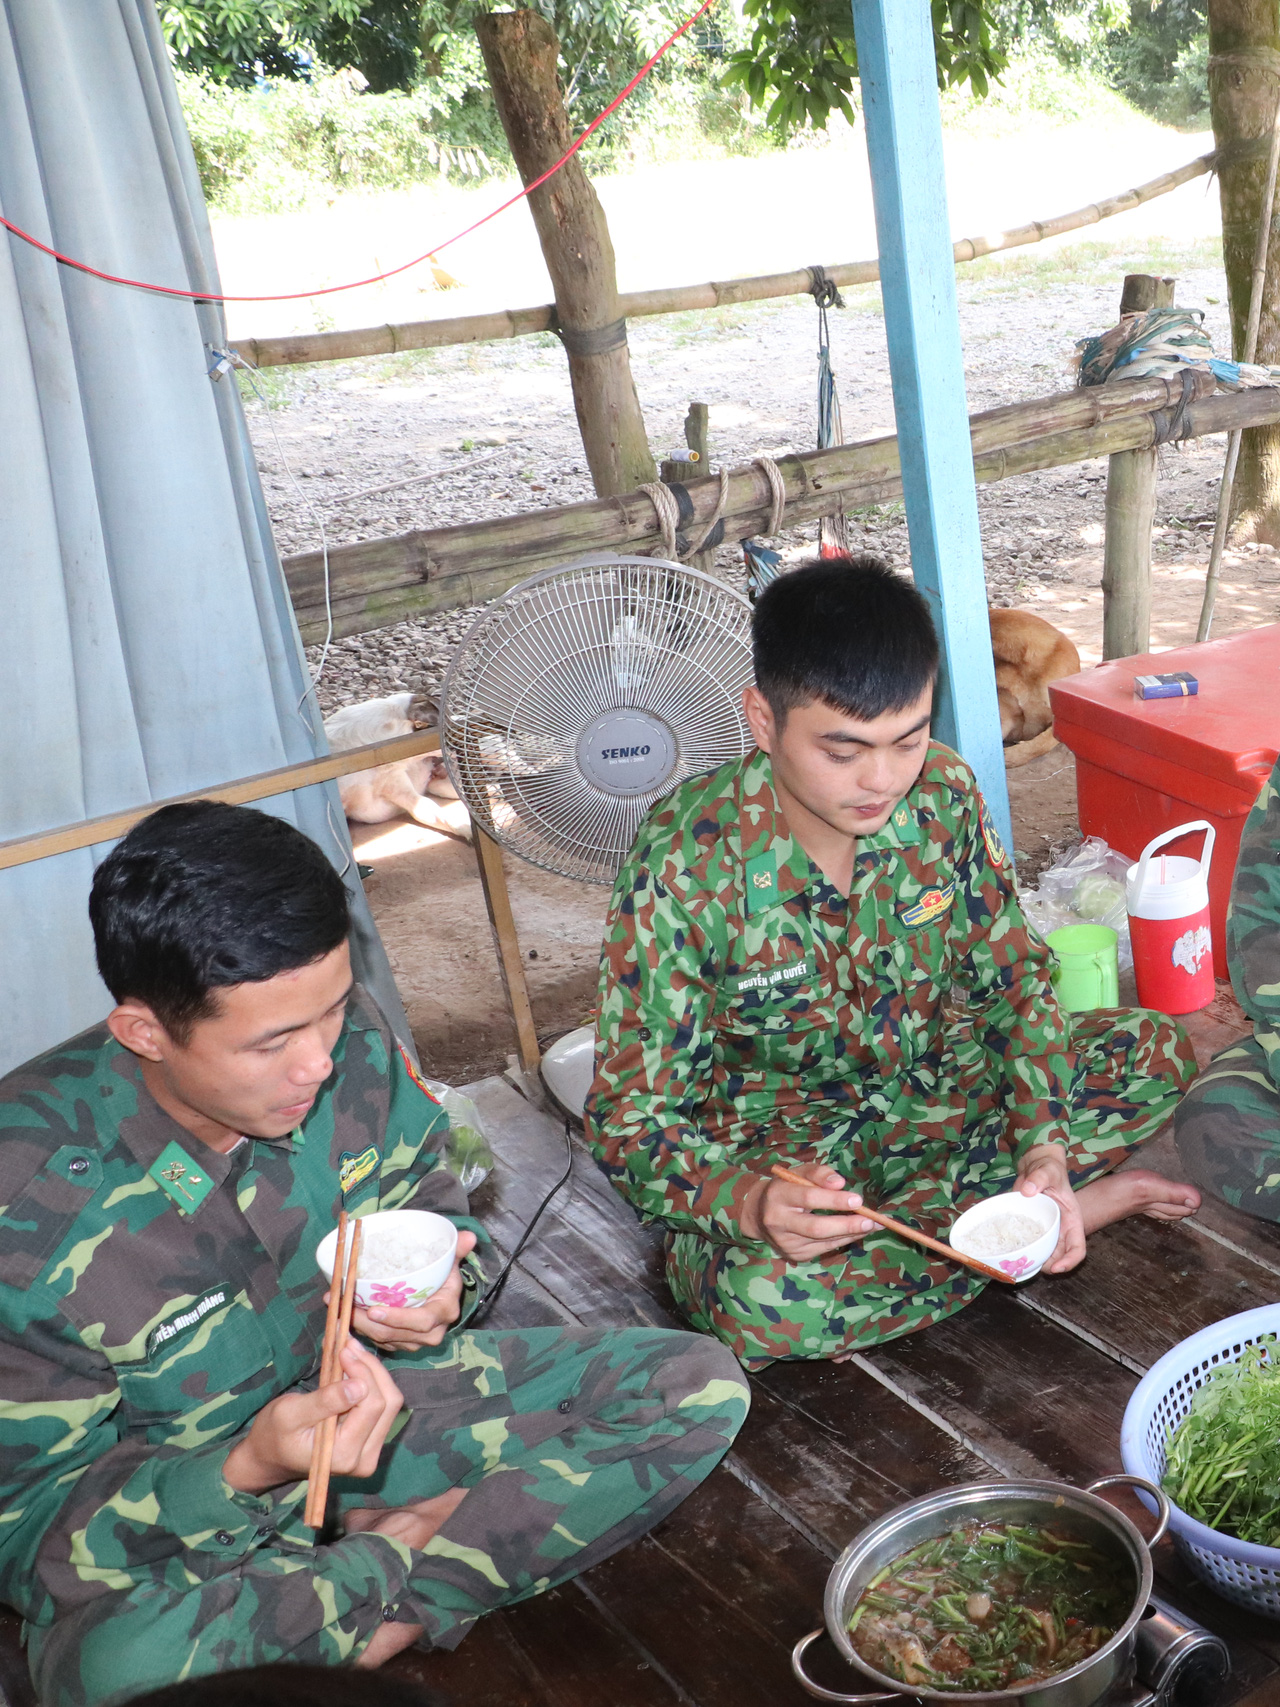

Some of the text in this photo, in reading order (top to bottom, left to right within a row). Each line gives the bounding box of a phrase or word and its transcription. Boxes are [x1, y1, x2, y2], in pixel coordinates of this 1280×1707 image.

[601, 744, 651, 760] SENKO
[173, 1308, 200, 1332] MINH
[196, 1291, 226, 1317] HOÀNG
